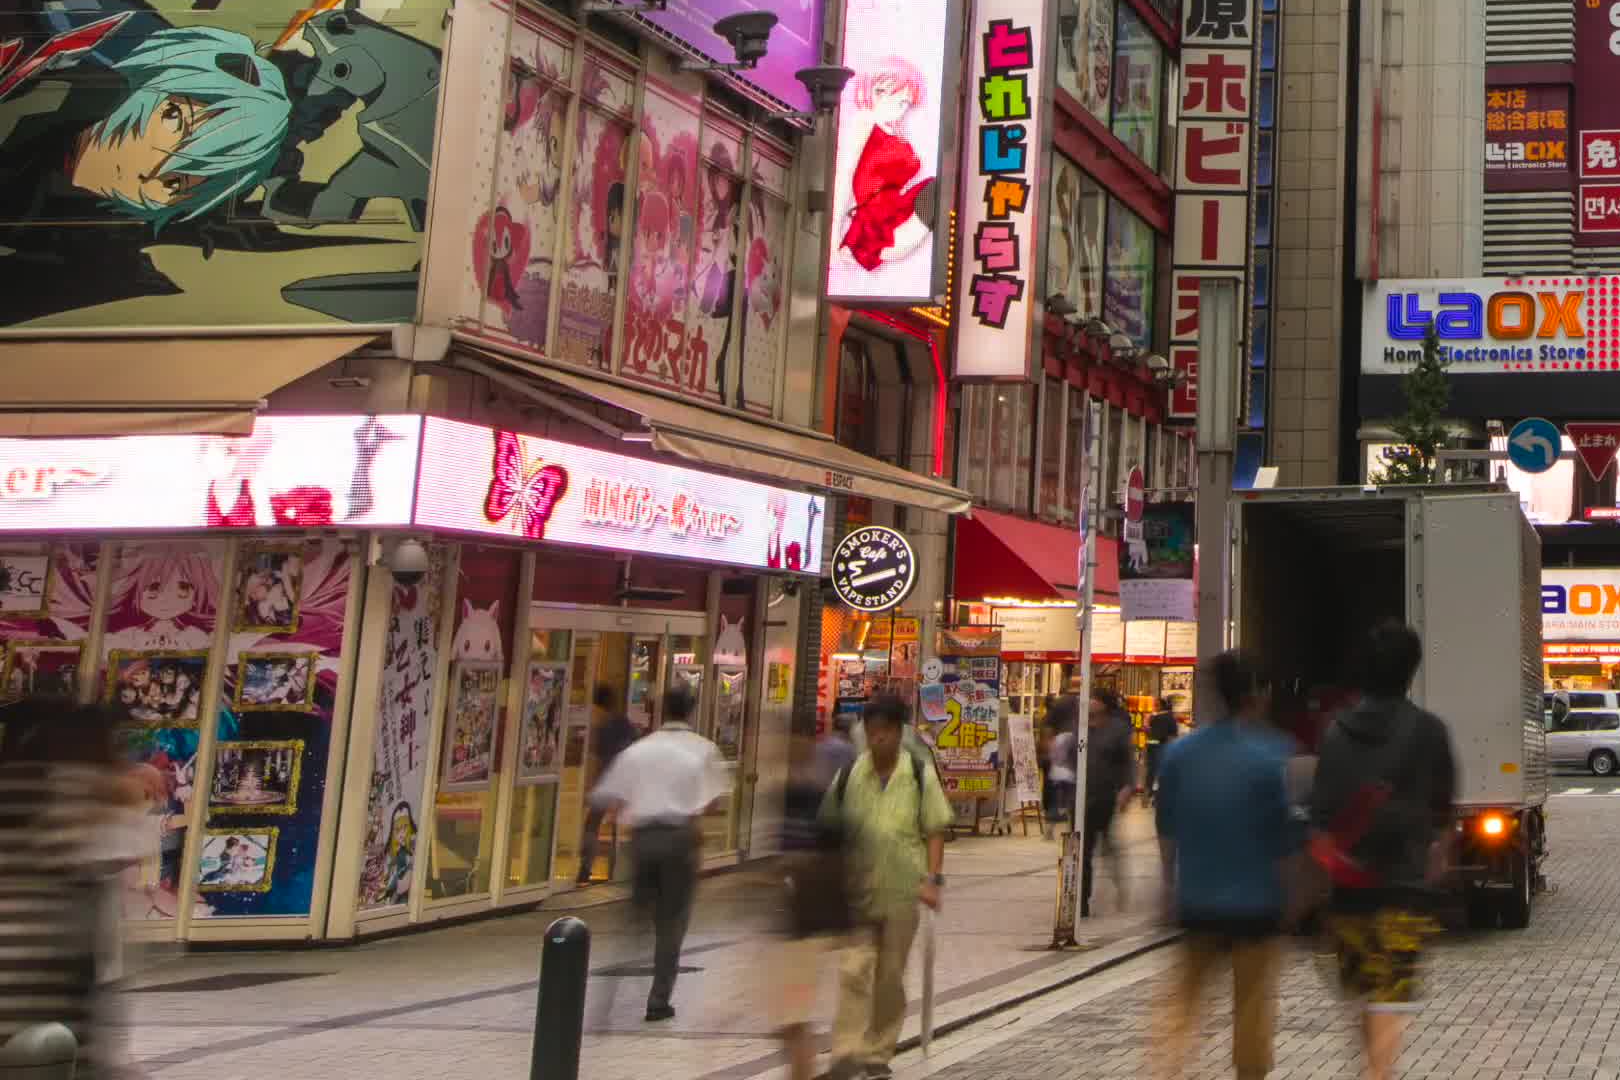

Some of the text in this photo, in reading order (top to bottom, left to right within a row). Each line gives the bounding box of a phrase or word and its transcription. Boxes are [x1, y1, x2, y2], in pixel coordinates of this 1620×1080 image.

[1486, 88, 1527, 110] 本店
[1486, 109, 1567, 132] 総合家電
[1547, 160, 1567, 168] Store
[1384, 344, 1586, 363] Hom Electronics Store
[1578, 434, 1617, 448] 止まれ
[840, 529, 908, 559] SMOKER'S
[859, 545, 888, 563] Cafe
[838, 577, 904, 606] VAPE STAND
